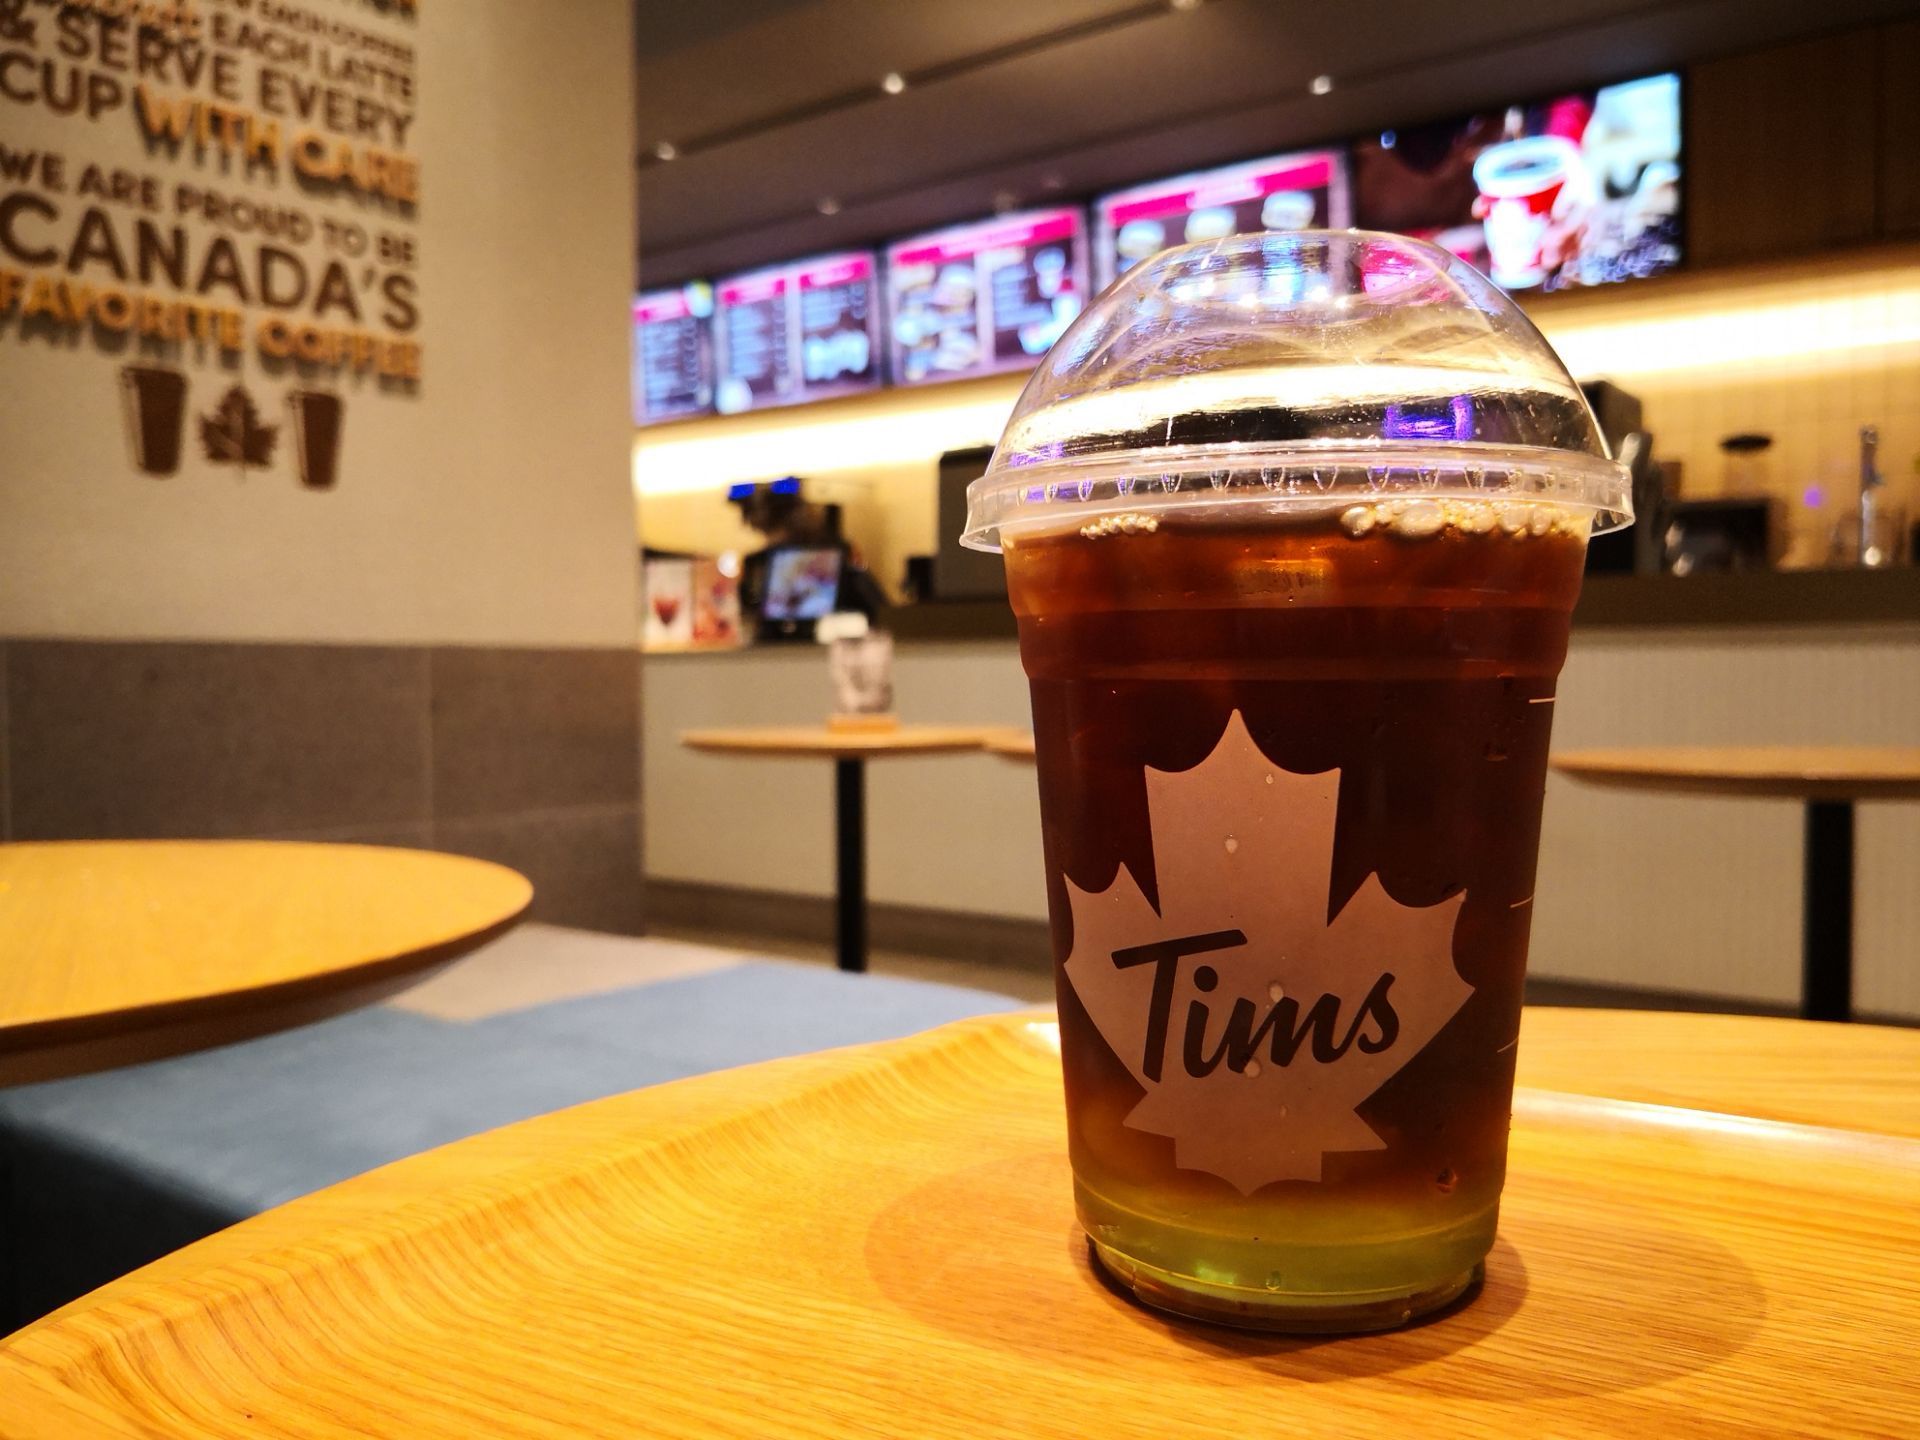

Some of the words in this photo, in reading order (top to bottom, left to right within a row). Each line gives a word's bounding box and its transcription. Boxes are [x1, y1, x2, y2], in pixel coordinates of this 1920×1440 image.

[56, 4, 241, 101] SERVE
[257, 66, 414, 147] EVERY
[211, 11, 311, 68] EACH
[0, 50, 124, 122] CUP
[134, 82, 282, 174] WITH
[292, 130, 420, 206] CARE
[0, 142, 65, 194] WE
[78, 163, 161, 211] ARE
[175, 184, 314, 246] PROUD
[320, 214, 369, 259] TO
[377, 231, 415, 266] BE
[0, 190, 420, 333] CANADA'S
[0, 264, 244, 358] FAVORITE
[256, 316, 422, 384] COFFEE
[1111, 929, 1400, 1084] Tims
